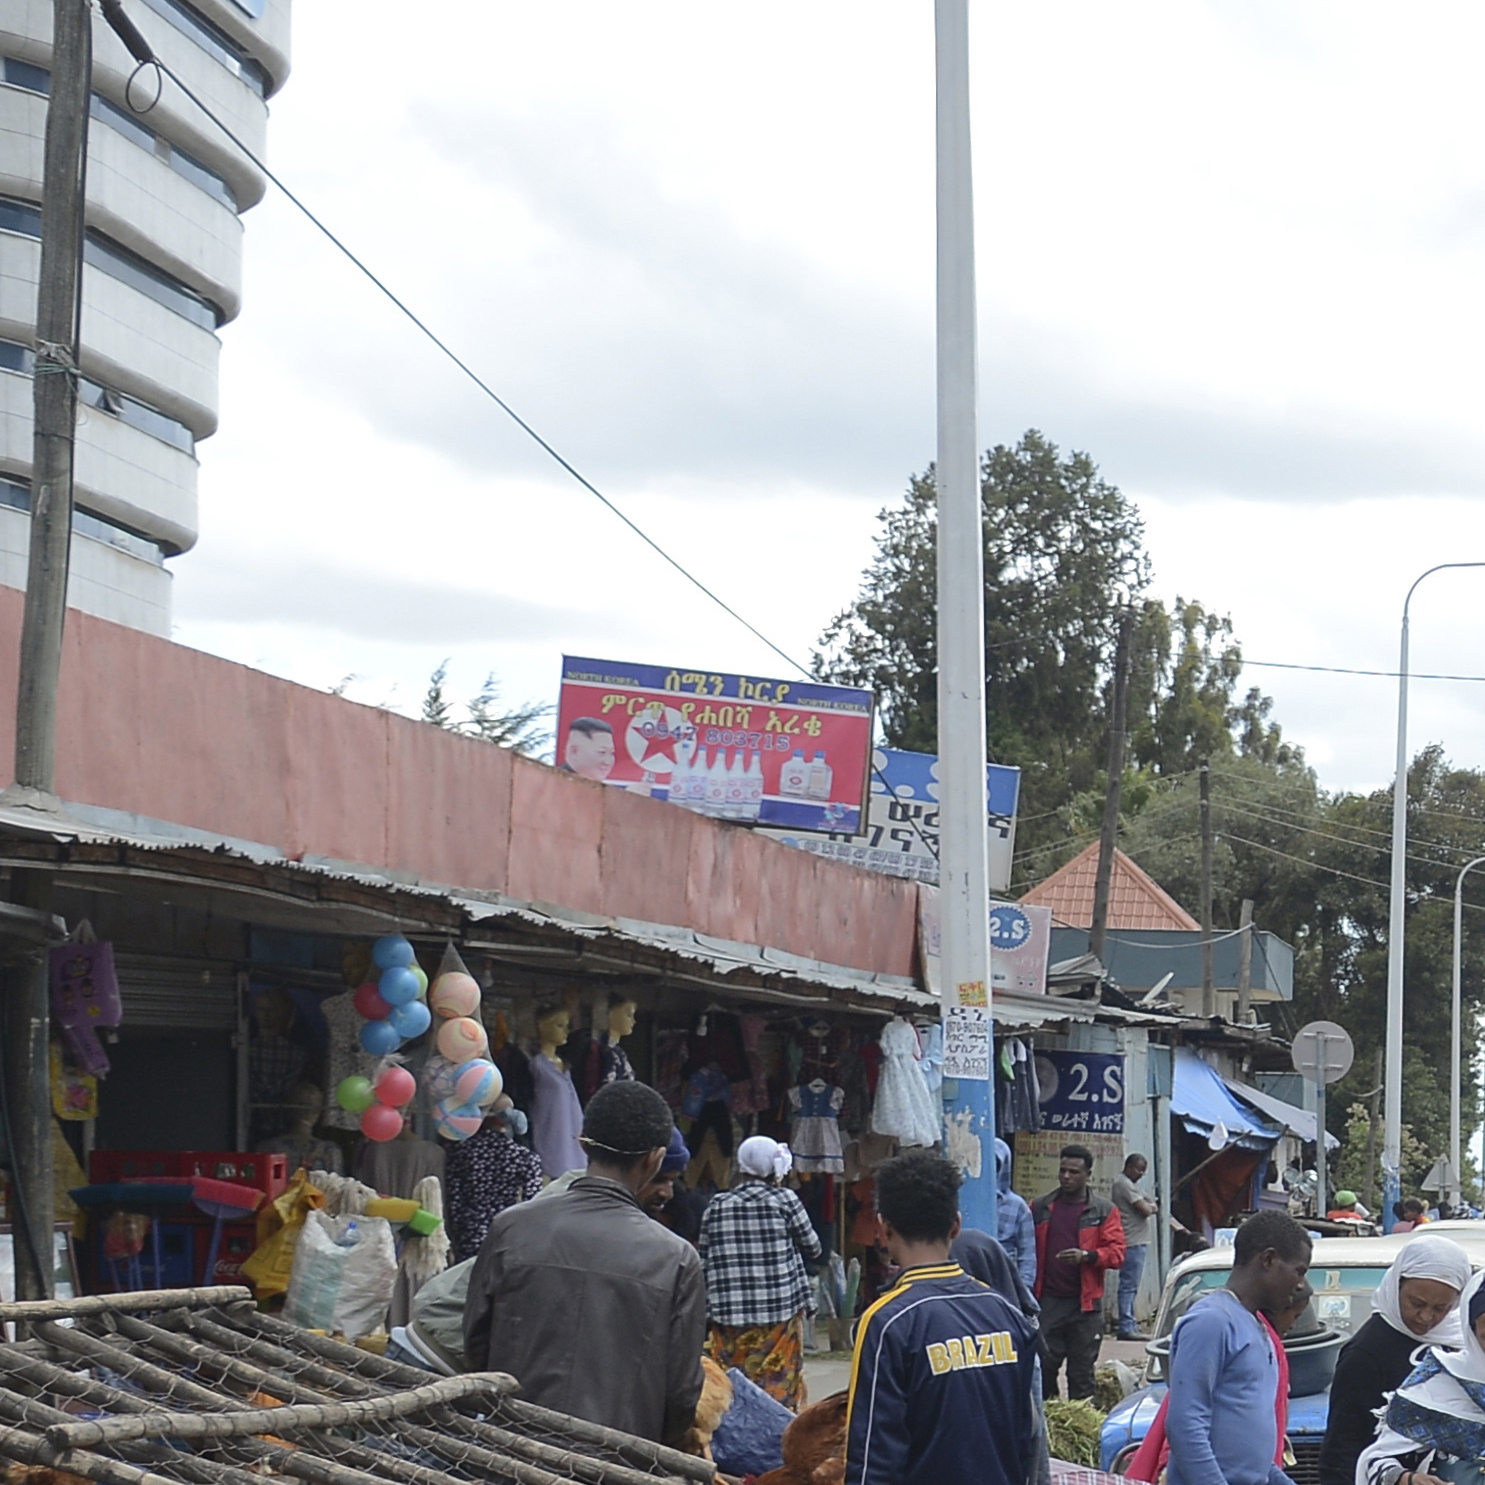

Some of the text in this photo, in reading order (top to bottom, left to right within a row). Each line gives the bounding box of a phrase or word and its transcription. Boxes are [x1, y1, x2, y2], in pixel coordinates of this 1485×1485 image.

[567, 671, 640, 686] NORTH KOREA
[797, 697, 868, 712] NORTH KOREA
[641, 721, 790, 751] 0947 803715
[1068, 1063, 1122, 1104] 2.S
[925, 1331, 1018, 1377] BRAZIL
